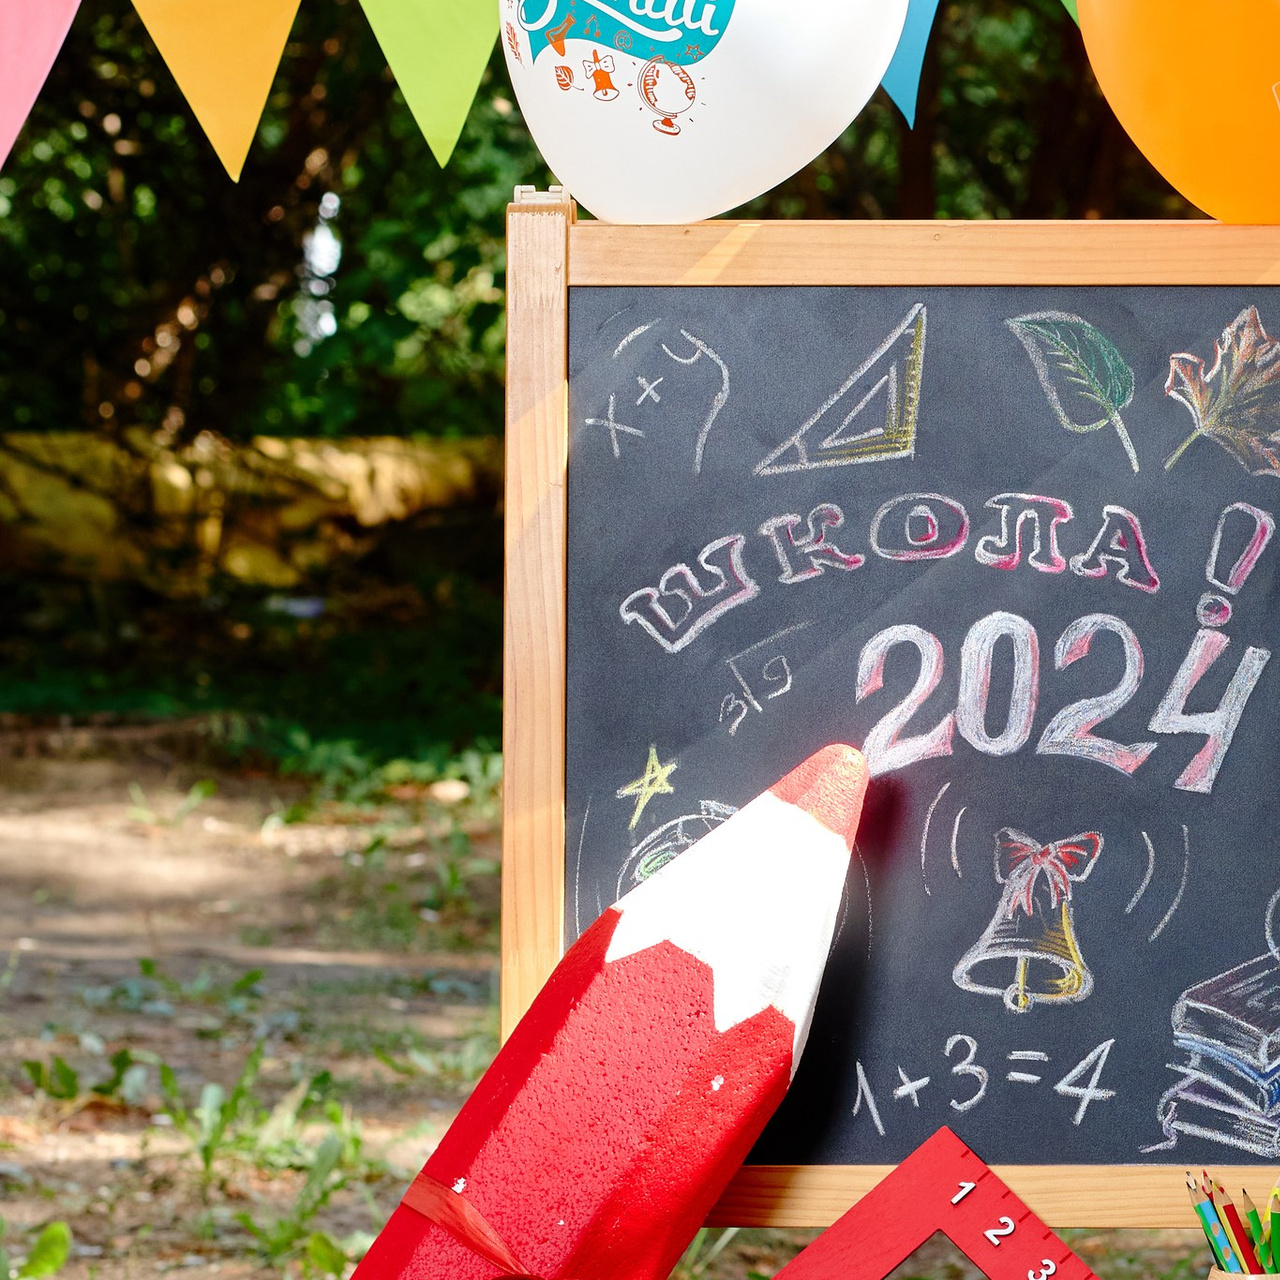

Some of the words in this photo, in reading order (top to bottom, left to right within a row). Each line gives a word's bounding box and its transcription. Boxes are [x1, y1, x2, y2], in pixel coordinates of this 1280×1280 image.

[855, 610, 1272, 795] 2024
[950, 1180, 977, 1206] 1
[983, 1216, 1016, 1247] 2
